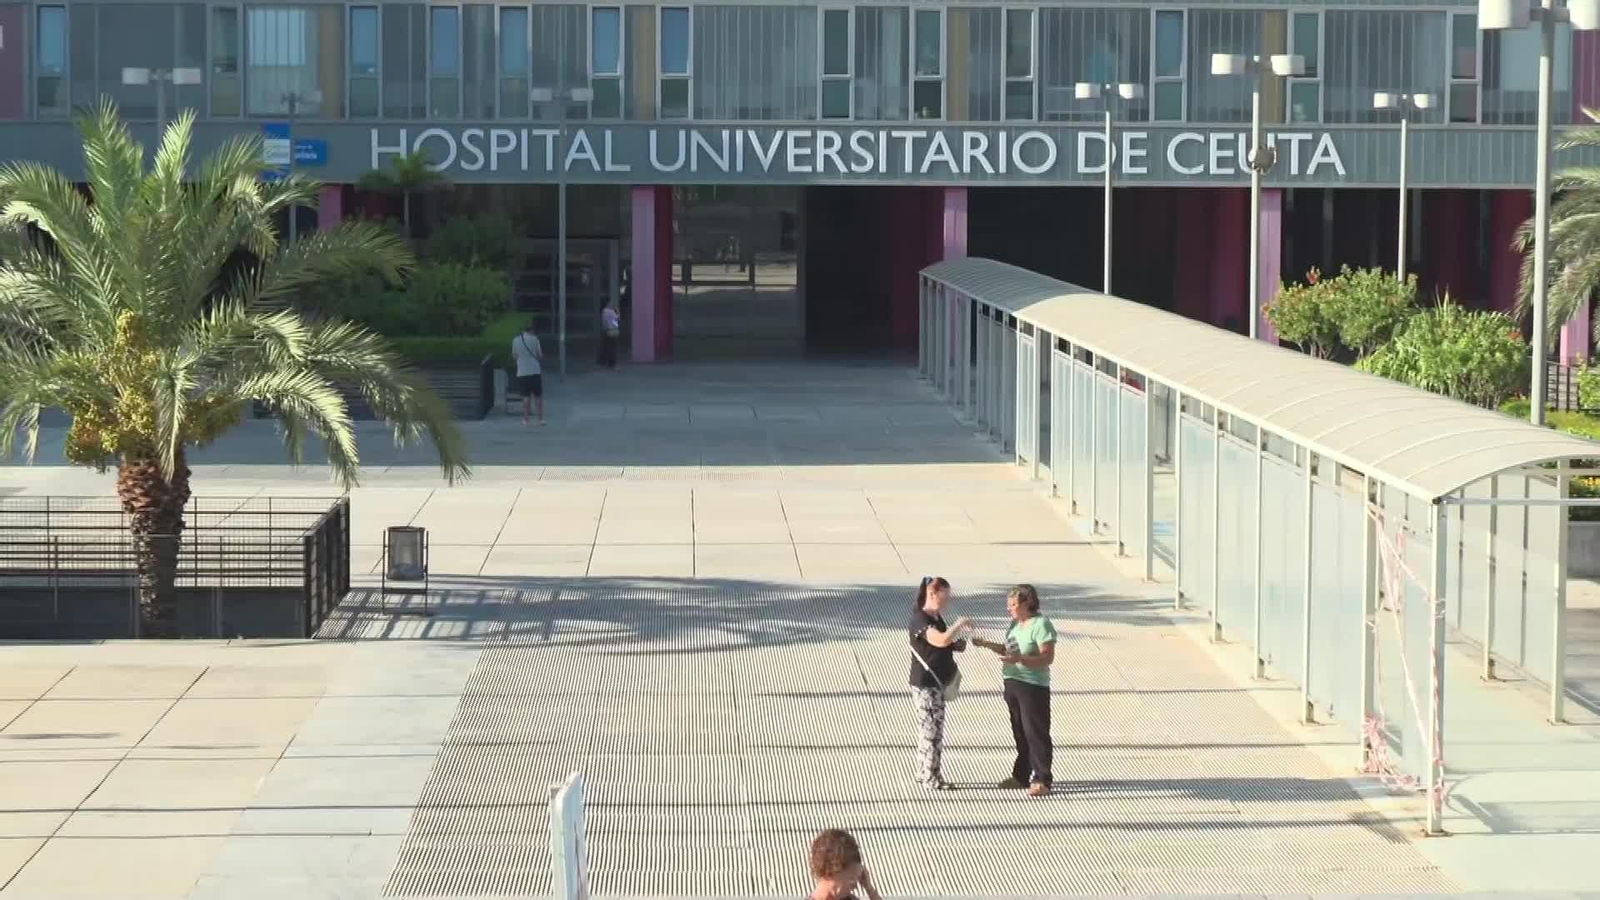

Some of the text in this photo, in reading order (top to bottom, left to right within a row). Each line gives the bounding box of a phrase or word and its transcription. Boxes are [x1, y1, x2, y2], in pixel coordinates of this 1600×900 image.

[370, 128, 631, 173] HOSPITAL
[649, 128, 1057, 175] UNIVERSITARIO
[1077, 131, 1148, 175] DE
